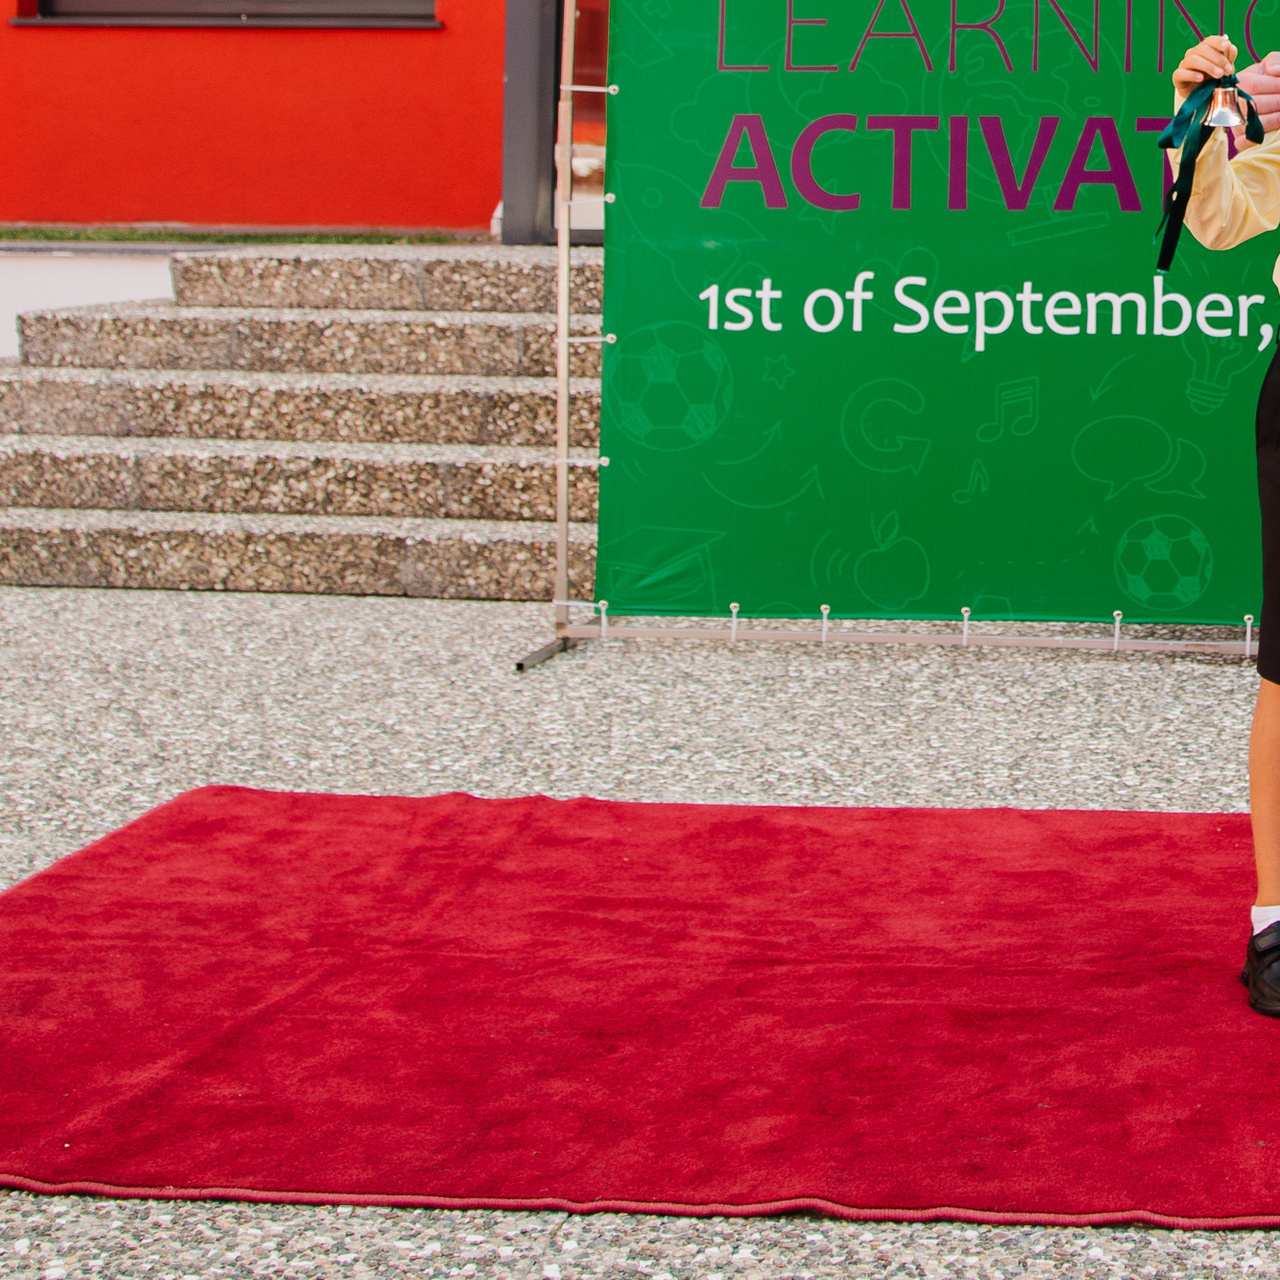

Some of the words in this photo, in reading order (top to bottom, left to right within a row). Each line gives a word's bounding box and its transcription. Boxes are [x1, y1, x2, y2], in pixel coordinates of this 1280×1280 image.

[698, 277, 782, 332] 1st
[803, 271, 875, 334] of
[893, 275, 1274, 353] September,
